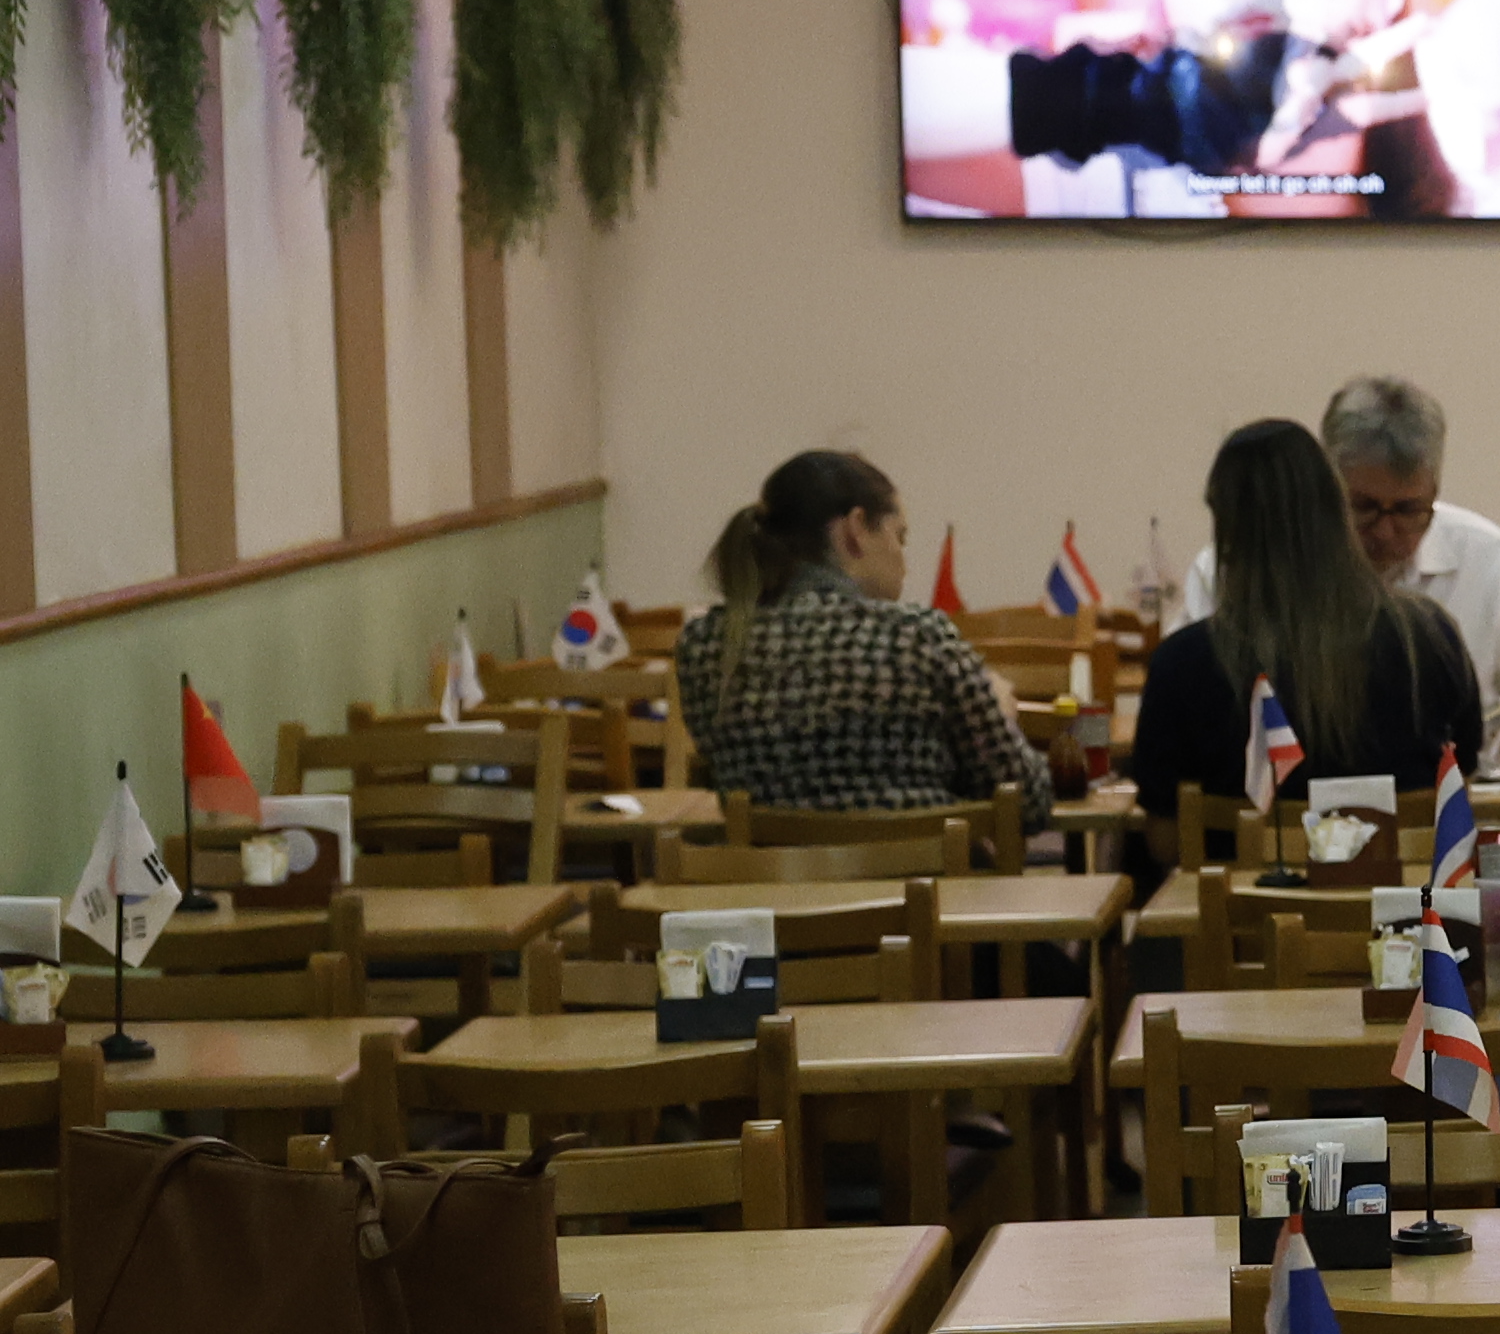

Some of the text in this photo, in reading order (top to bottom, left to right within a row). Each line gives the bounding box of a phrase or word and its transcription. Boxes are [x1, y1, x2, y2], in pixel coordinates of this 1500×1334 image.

[1187, 172, 1385, 197] Never let it go oh oh oh
